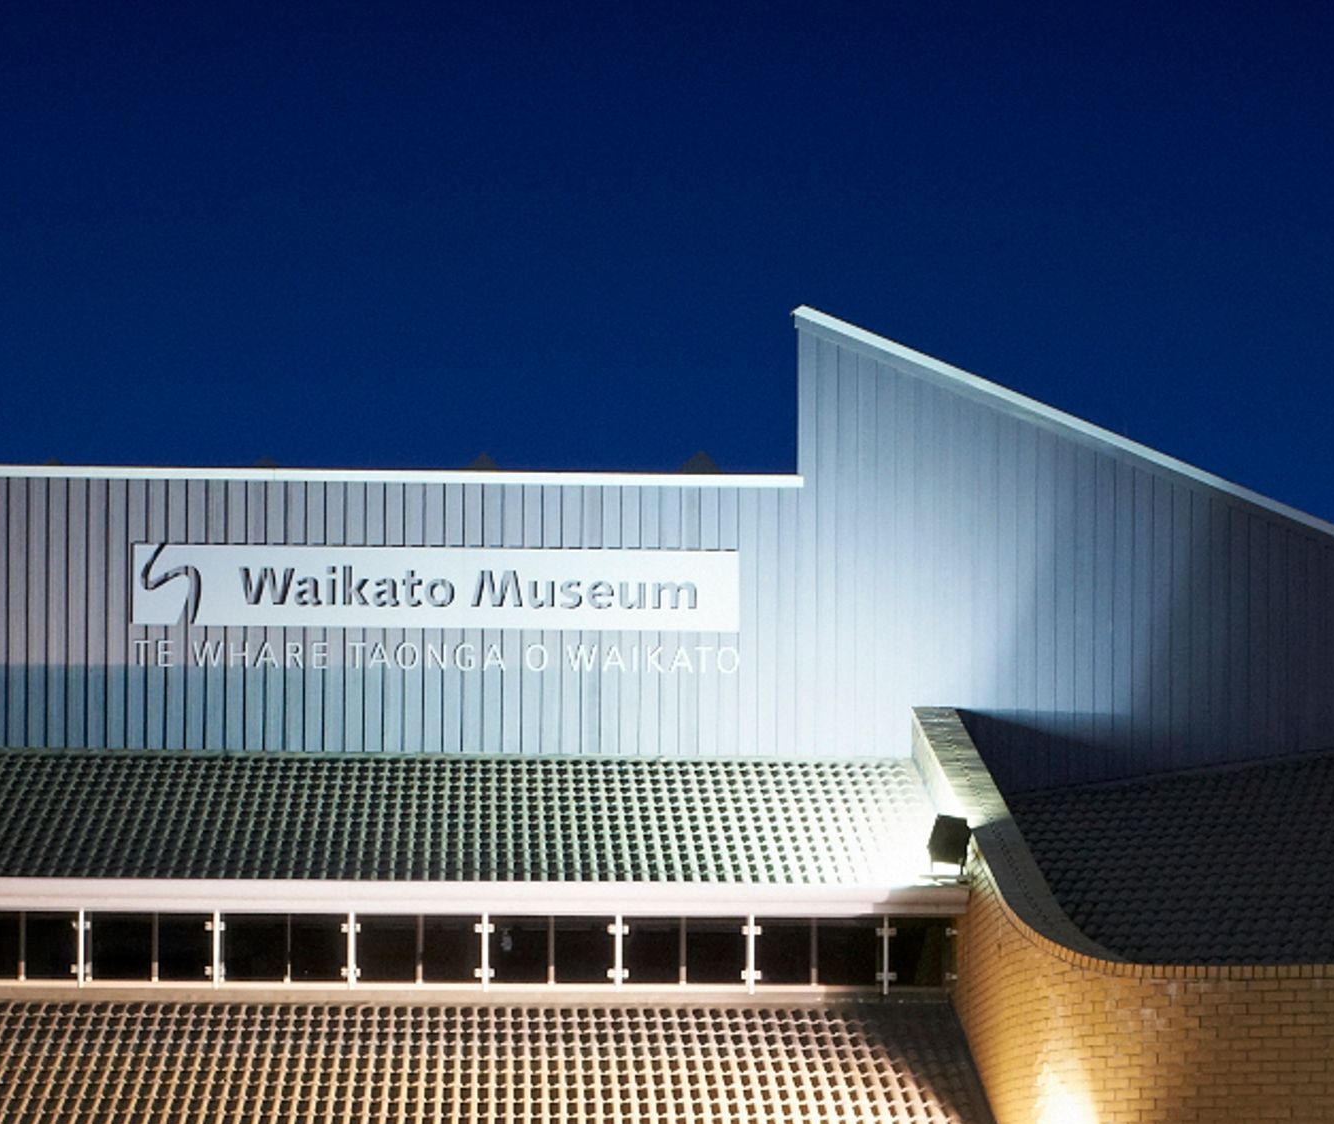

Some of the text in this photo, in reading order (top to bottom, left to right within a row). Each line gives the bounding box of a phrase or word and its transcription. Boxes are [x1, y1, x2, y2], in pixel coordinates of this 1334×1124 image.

[239, 566, 698, 609] Waikato Museum
[134, 640, 740, 673] TE WHARE TAONGA O WAIKATO
